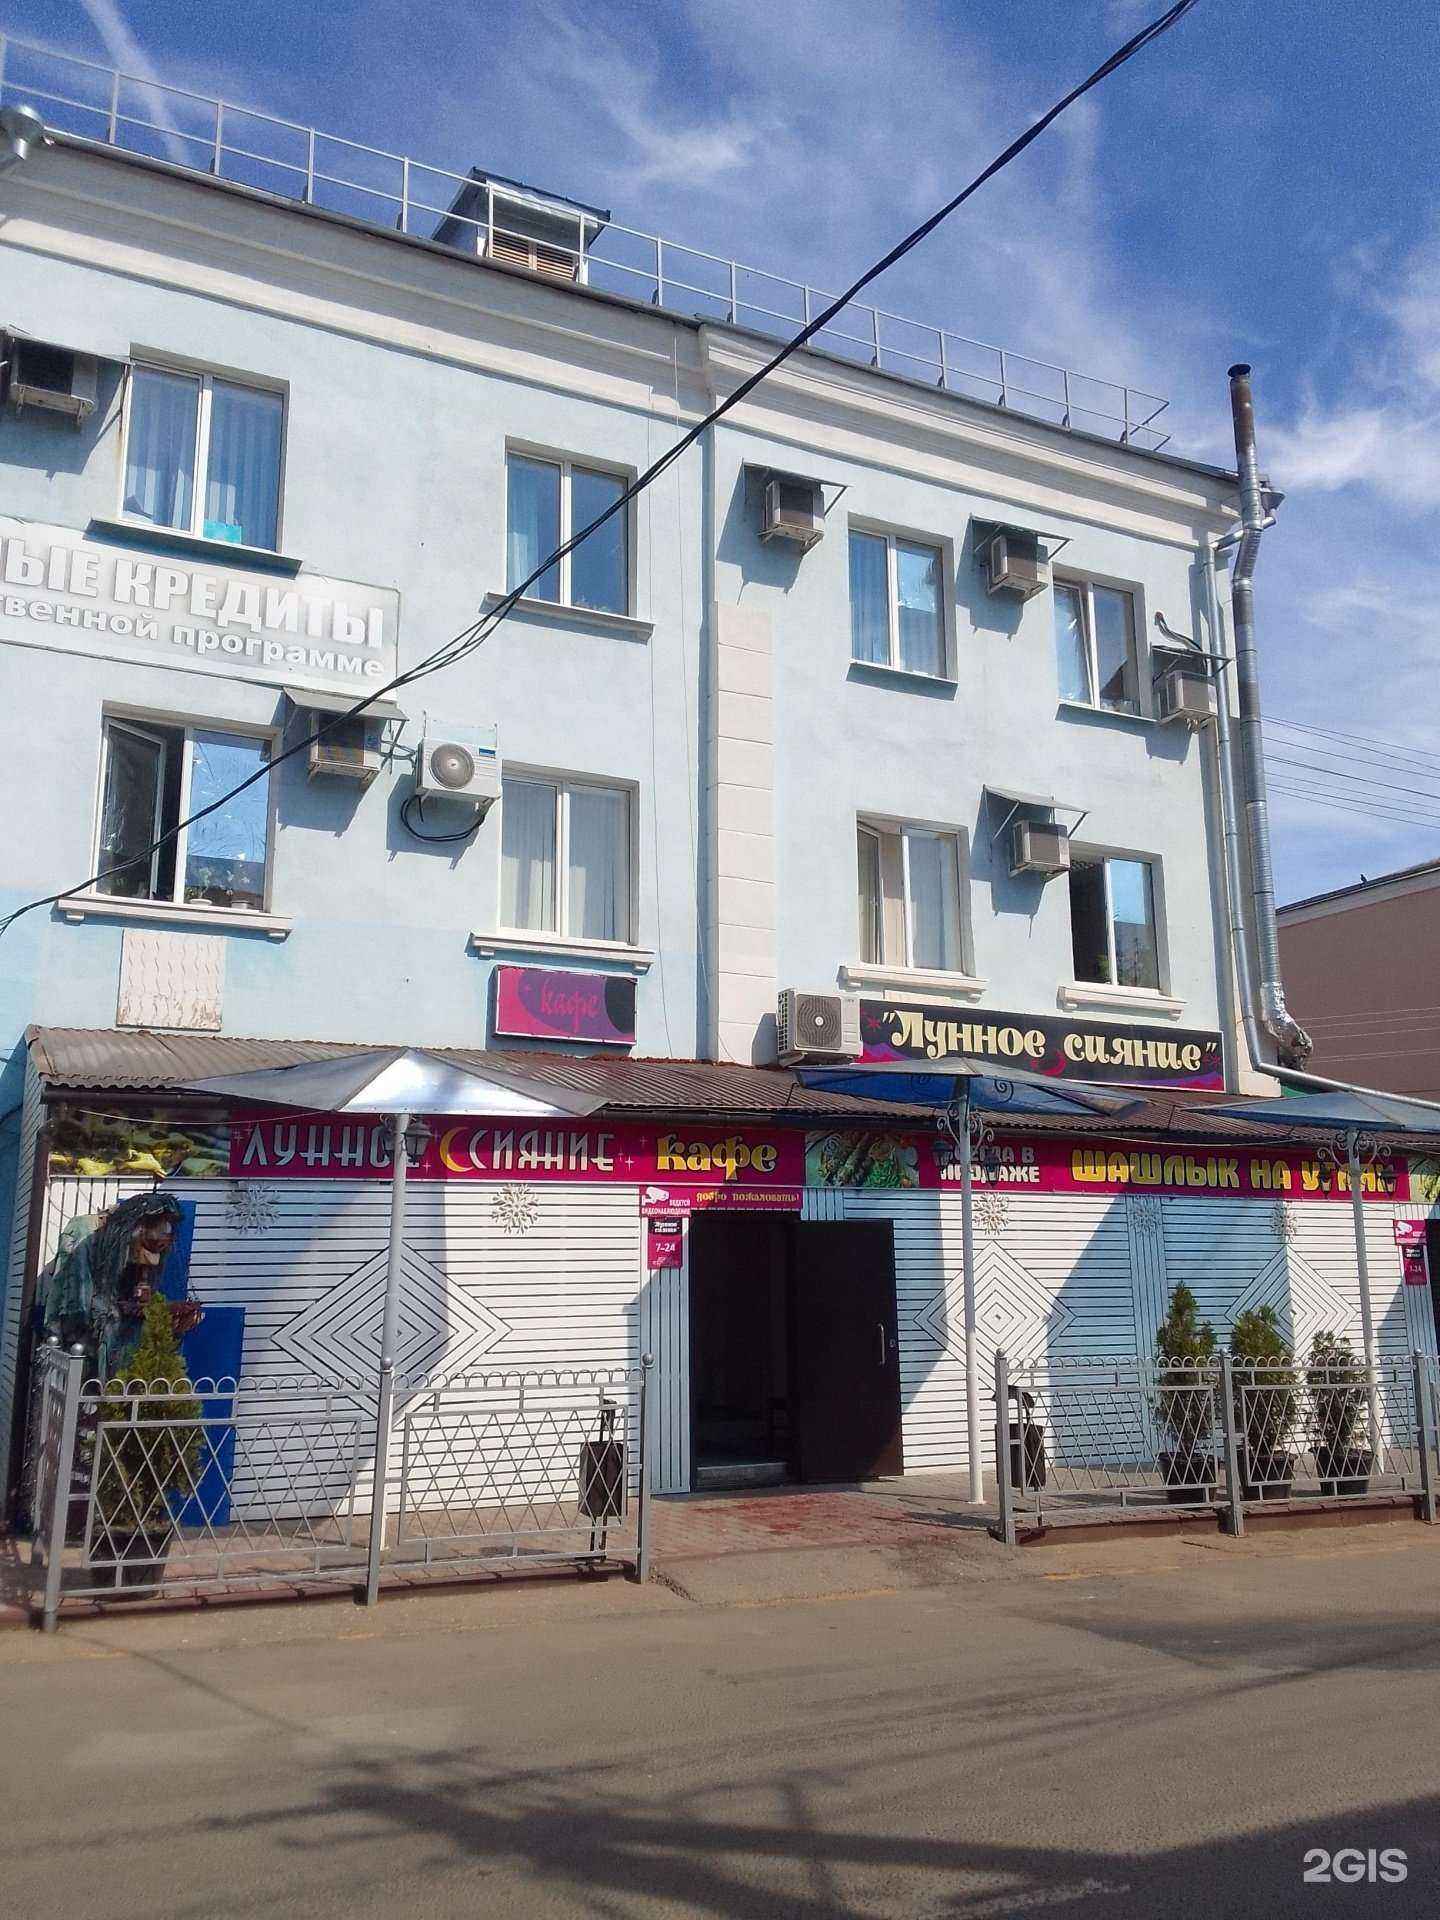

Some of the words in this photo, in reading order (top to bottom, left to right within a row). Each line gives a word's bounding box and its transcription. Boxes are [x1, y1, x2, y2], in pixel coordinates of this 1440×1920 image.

[0, 536, 99, 599] ЫЕ
[113, 557, 385, 649] КРЕДИТЫ
[0, 592, 160, 640] венной
[172, 624, 385, 677] программе
[882, 1009, 1046, 1060] "Лунное
[1064, 1032, 1217, 1071] сияние"
[242, 1124, 420, 1169] ЛУННО
[468, 1129, 616, 1172] СИЯНИЕ
[1021, 1146, 1035, 1164] В
[1071, 1149, 1240, 1188] ШАШЛЫК
[1251, 1159, 1292, 1190] НА
